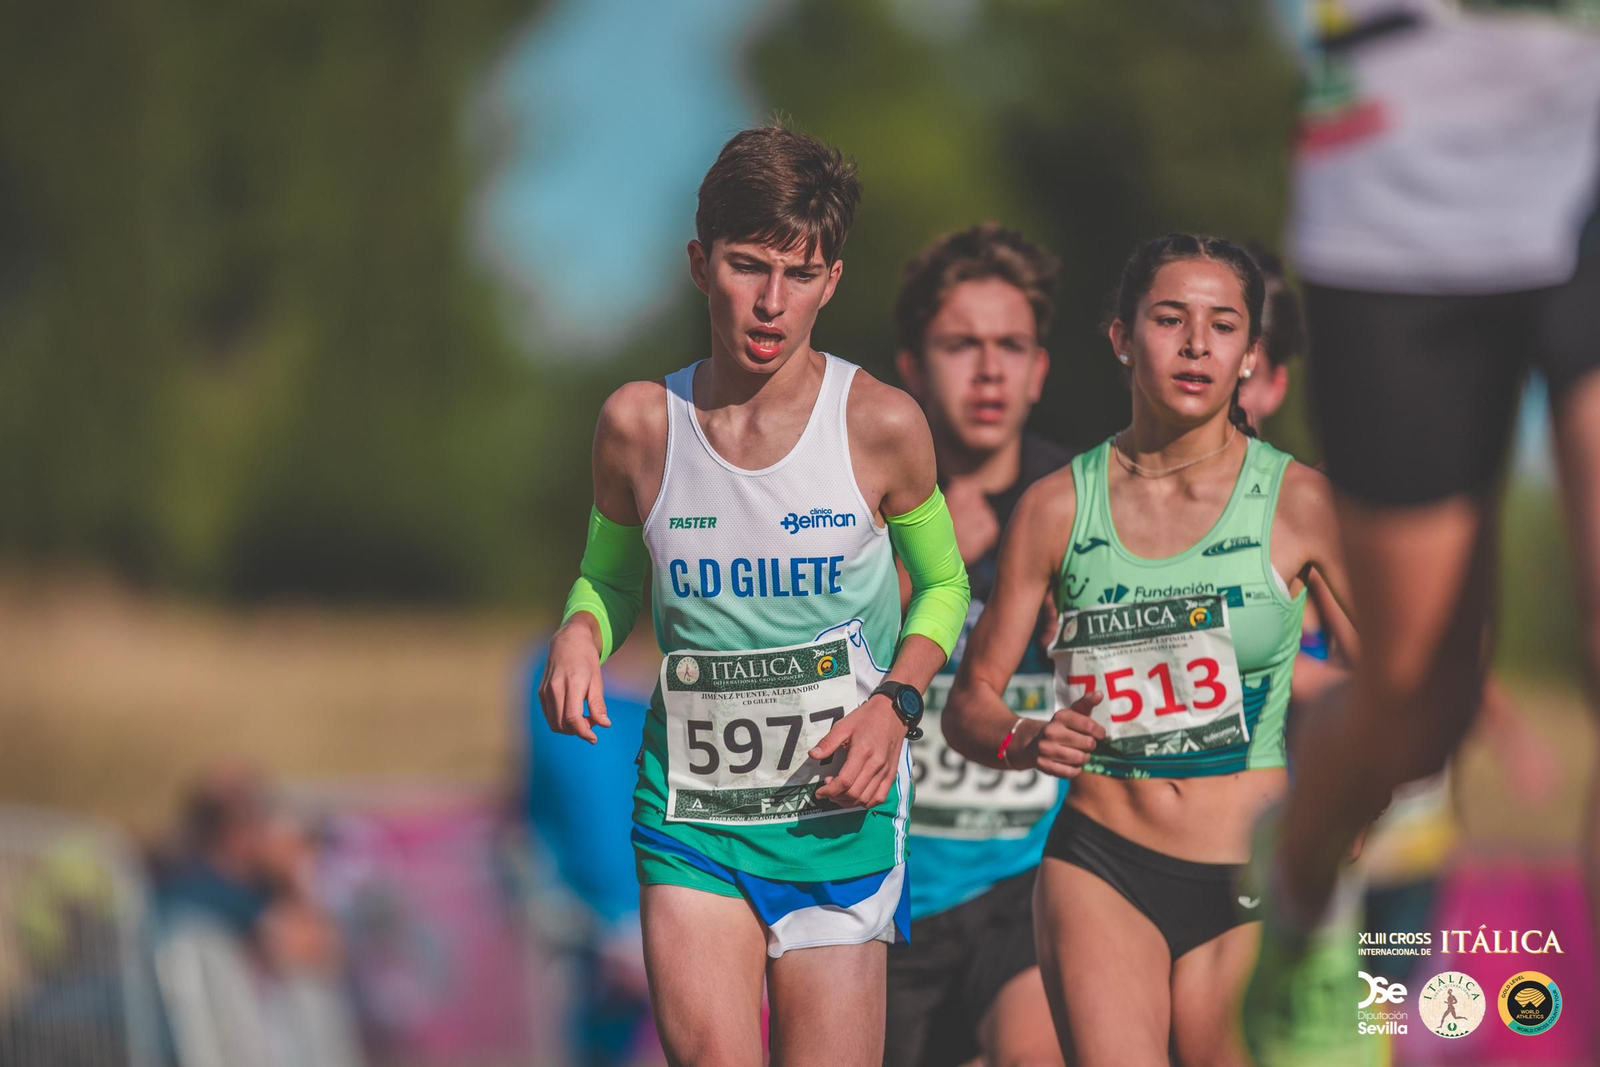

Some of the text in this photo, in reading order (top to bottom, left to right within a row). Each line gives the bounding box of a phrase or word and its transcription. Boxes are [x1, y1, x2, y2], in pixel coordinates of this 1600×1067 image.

[669, 516, 717, 529] FASTER
[783, 512, 856, 534] Beiman
[670, 556, 844, 598] C.D GILETE
[1134, 582, 1214, 598] Fundación
[1087, 605, 1176, 634] ITÁLICA
[712, 656, 803, 680] ITÁLICA
[736, 690, 769, 699] PUENTE,
[771, 684, 819, 696] ALEJANDRO
[687, 706, 845, 775] 5977
